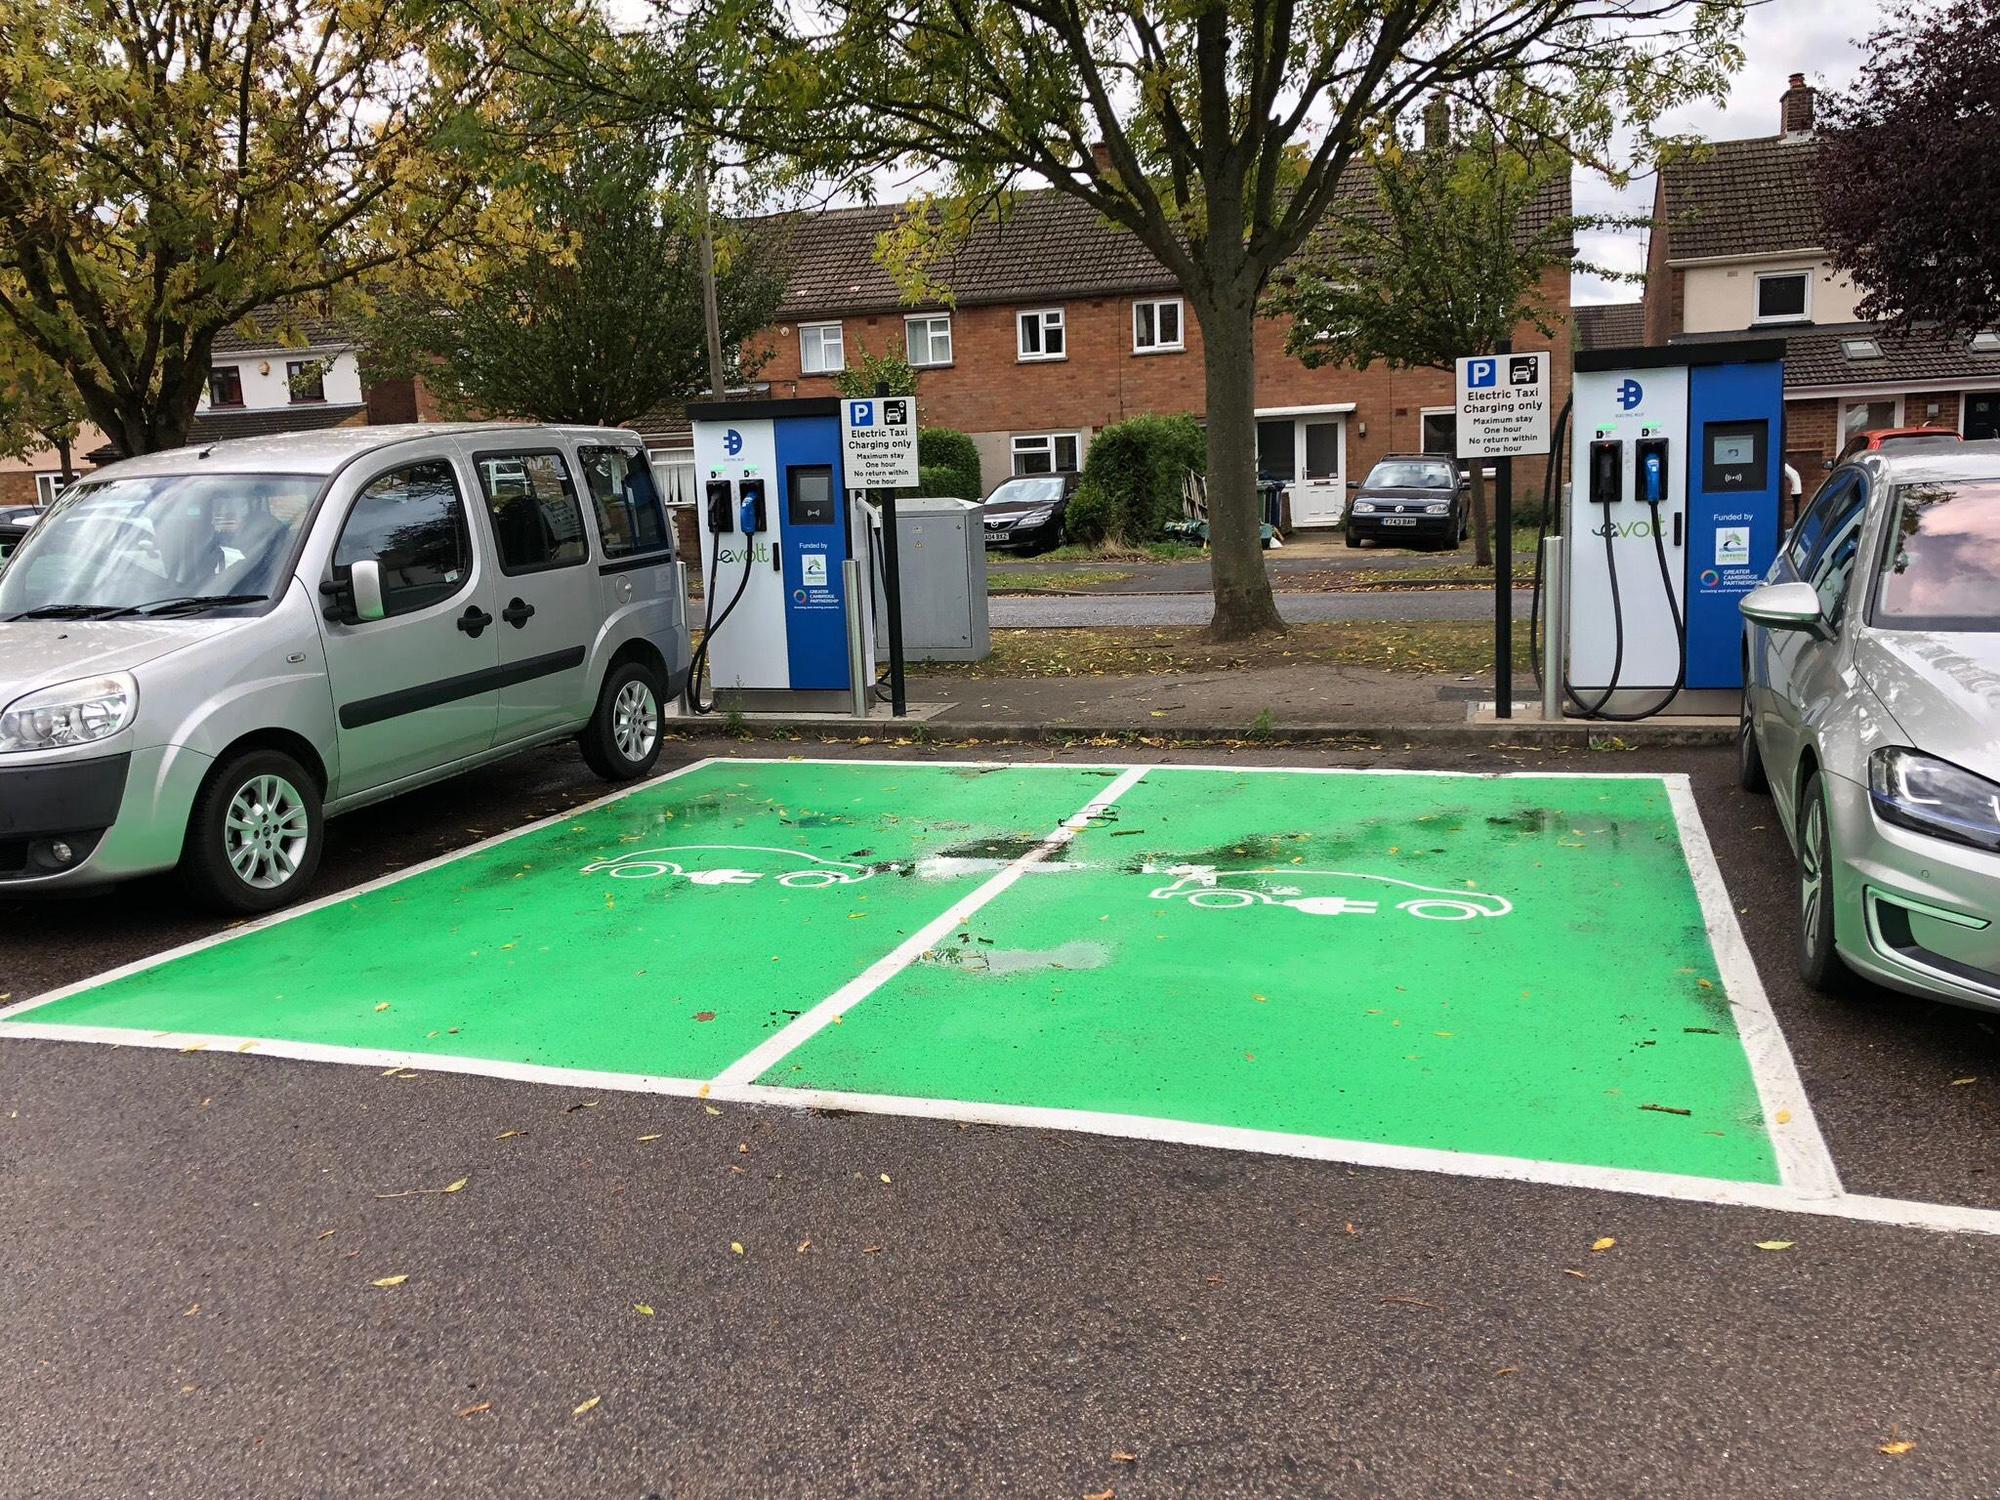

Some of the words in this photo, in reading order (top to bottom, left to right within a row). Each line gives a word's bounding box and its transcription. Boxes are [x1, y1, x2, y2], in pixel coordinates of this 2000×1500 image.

[1473, 362, 1490, 385] P
[1467, 390, 1511, 401] Electric
[1515, 387, 1538, 398] Taxi
[1464, 402, 1514, 413] Charging
[1518, 400, 1543, 410] only
[855, 404, 868, 424] P
[1473, 417, 1513, 425] Maximum
[1515, 415, 1533, 423] stay
[851, 429, 886, 438] Electric
[889, 428, 908, 436] Taxi
[1484, 426, 1500, 434] One
[1483, 436, 1509, 444] return
[1511, 434, 1538, 442] within
[848, 440, 889, 450] Charging
[892, 439, 911, 449] only
[1713, 513, 1742, 521] Funded
[1743, 513, 1753, 521] by
[1592, 513, 1667, 538] evot
[820, 542, 828, 550] by
